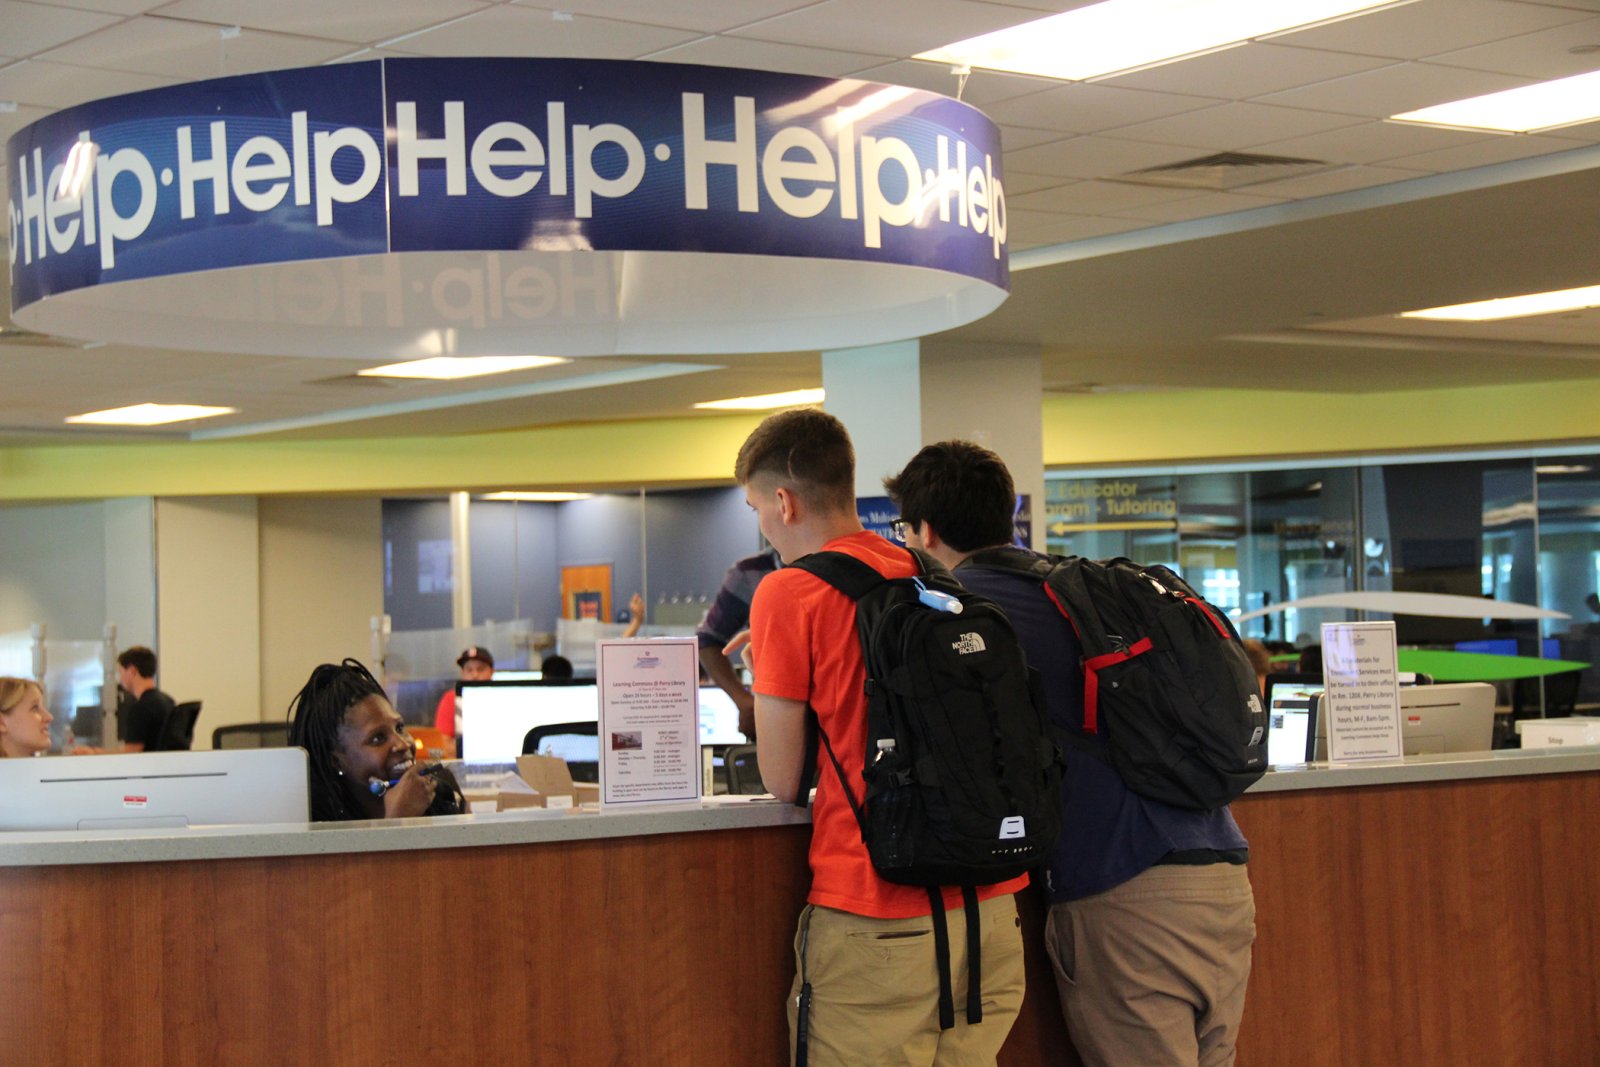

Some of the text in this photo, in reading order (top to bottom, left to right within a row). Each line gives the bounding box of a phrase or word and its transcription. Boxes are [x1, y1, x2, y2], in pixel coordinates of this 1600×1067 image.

[19, 130, 157, 270] Help
[177, 111, 381, 226] Help
[396, 101, 646, 218] Help
[682, 92, 922, 248] Help
[937, 134, 1007, 260] Help
[1058, 482, 1138, 499] Educator
[1106, 499, 1177, 517] Tutoring
[960, 633, 973, 642] THE
[952, 640, 974, 650] NORTH
[959, 647, 975, 656] FACE
